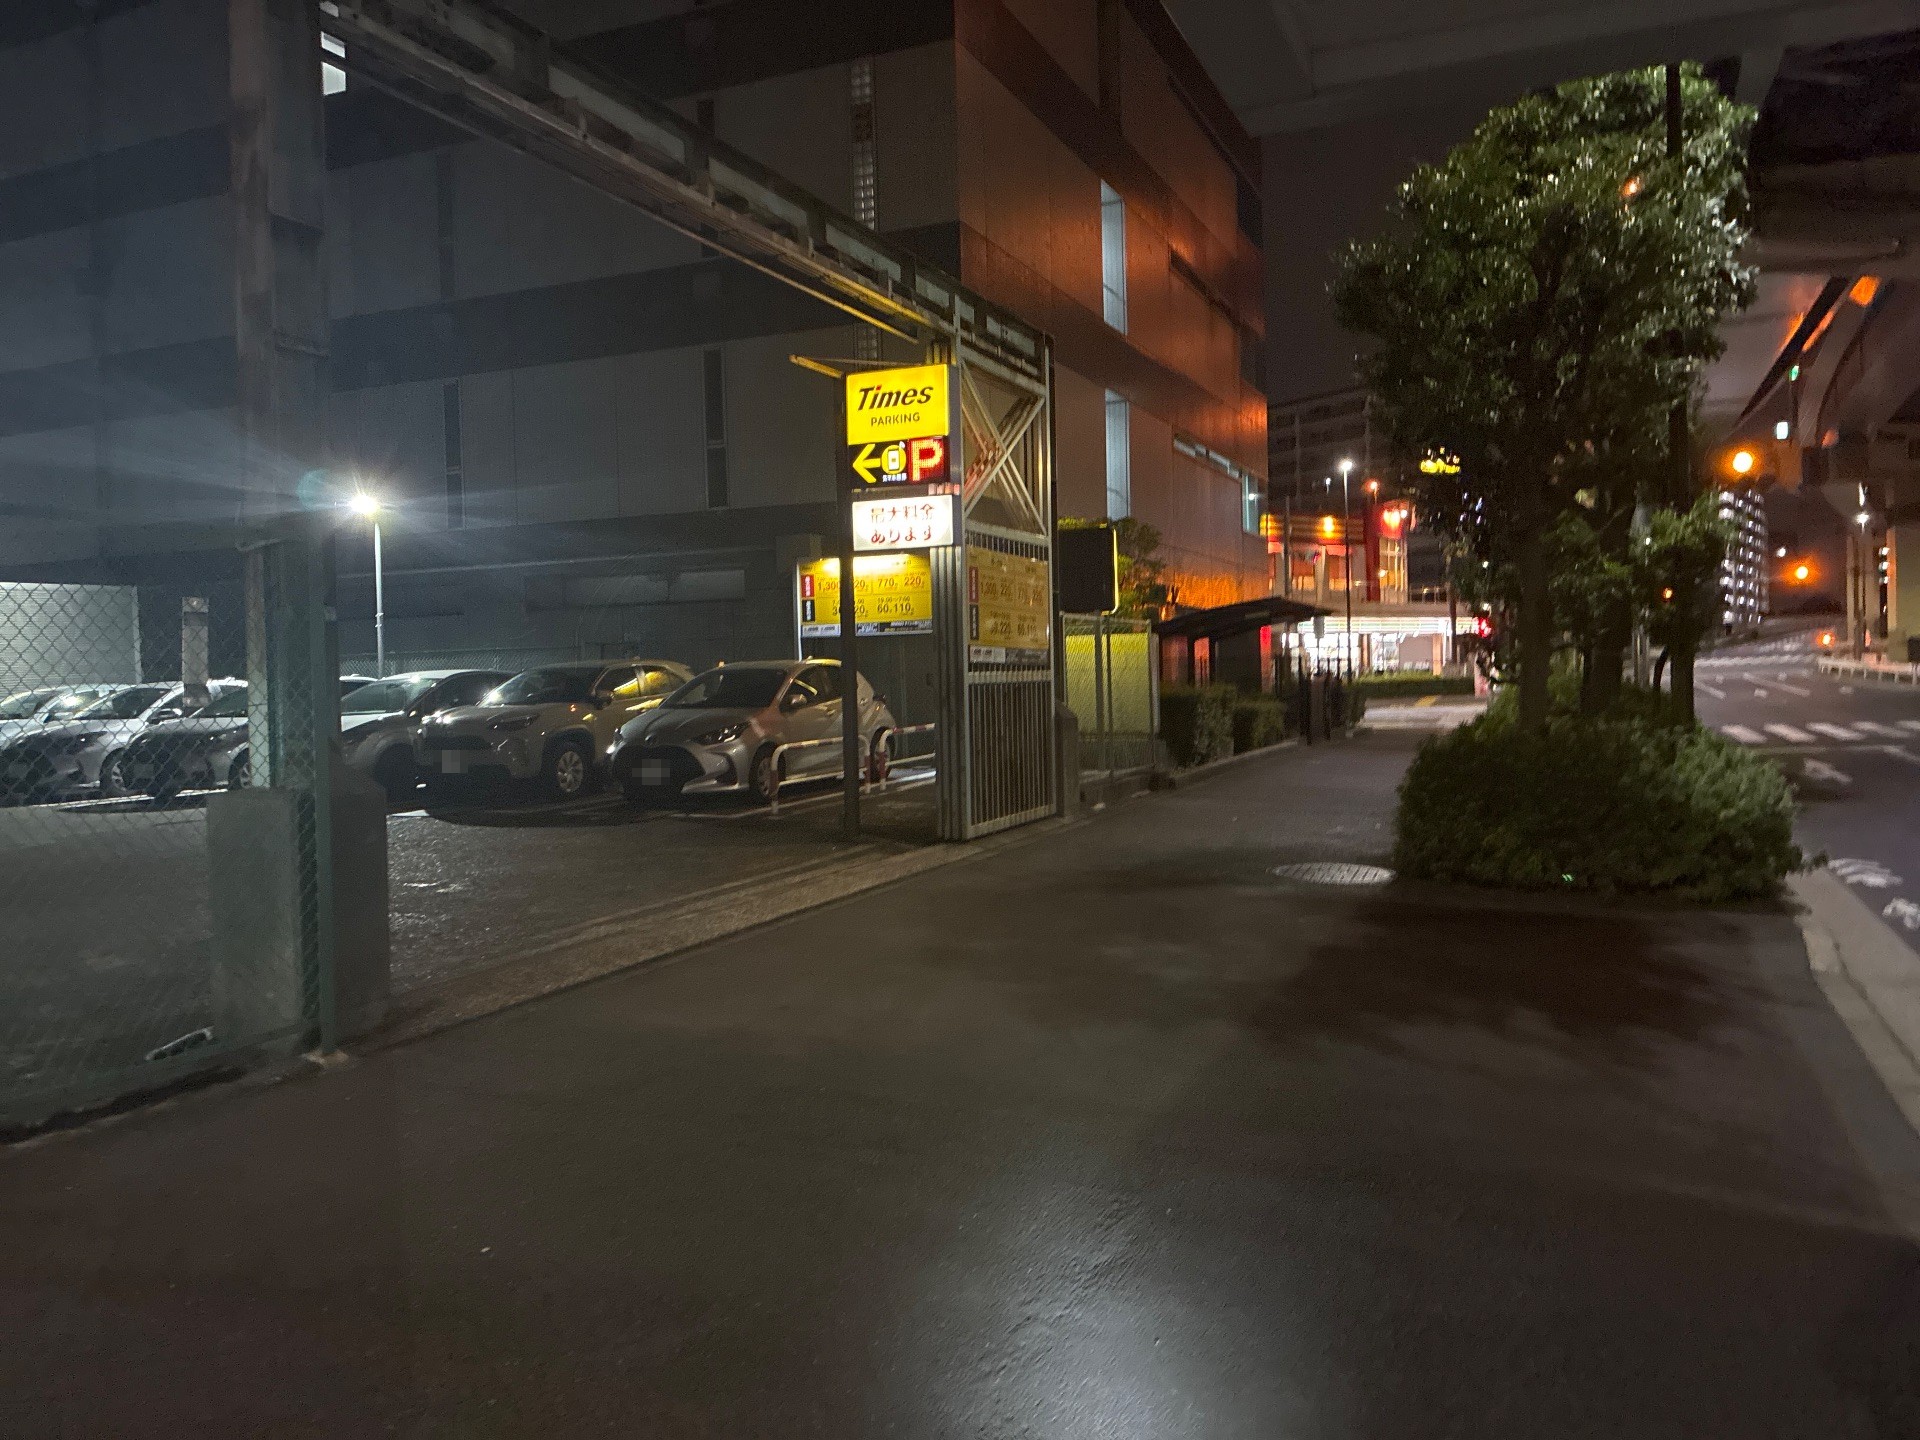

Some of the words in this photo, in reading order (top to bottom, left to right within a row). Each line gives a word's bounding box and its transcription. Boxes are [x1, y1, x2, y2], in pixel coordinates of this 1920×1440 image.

[858, 384, 934, 411] Times
[870, 412, 921, 427] PARKING
[911, 438, 943, 482] P
[871, 525, 932, 544] あります
[877, 577, 895, 588] 770
[903, 575, 922, 587] 220
